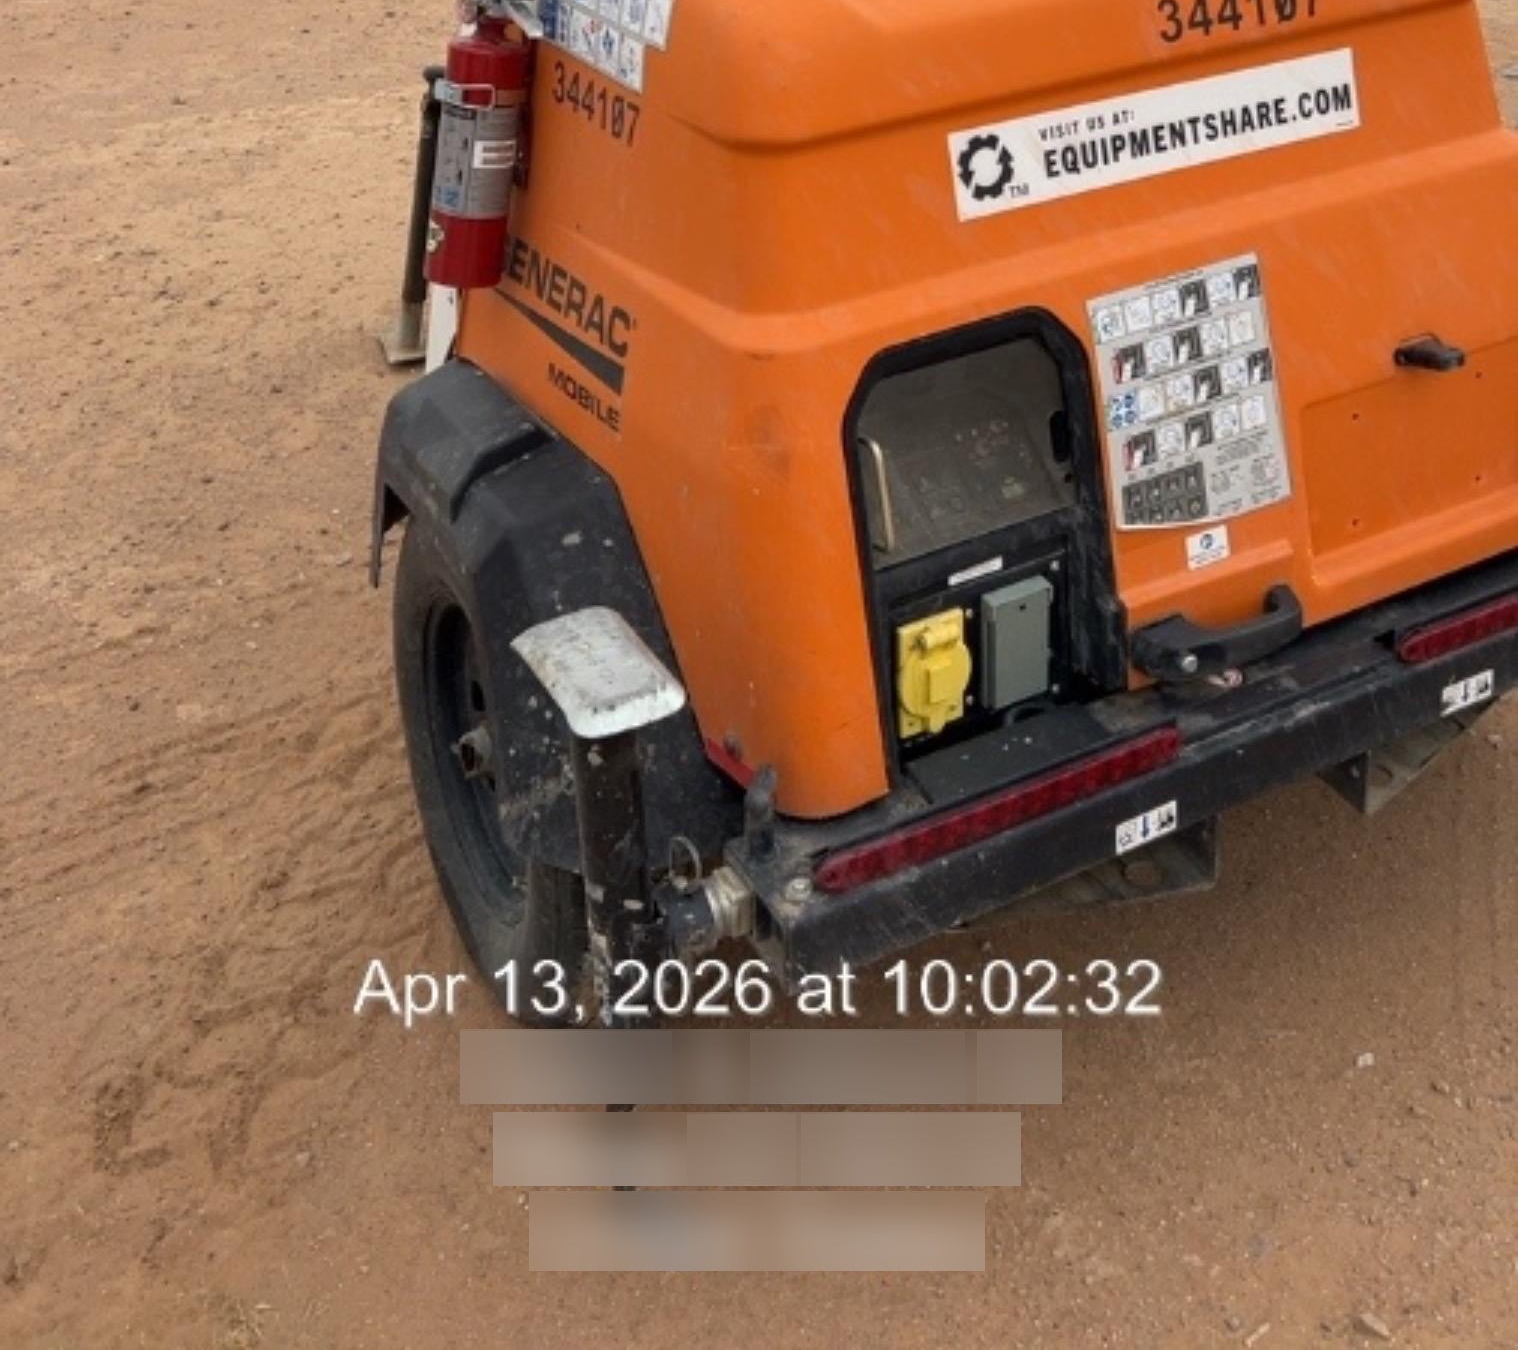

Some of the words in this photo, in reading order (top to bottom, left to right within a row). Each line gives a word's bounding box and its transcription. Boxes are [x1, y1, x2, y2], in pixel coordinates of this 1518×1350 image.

[552, 60, 640, 147] 344107
[1038, 119, 1079, 141] VISIT
[1086, 114, 1105, 131] US
[1112, 109, 1135, 127] AT:
[1043, 83, 1352, 178] EQUIPMENTSHARE.COM
[507, 236, 631, 358] ENERAC
[547, 361, 621, 433] MOBILE
